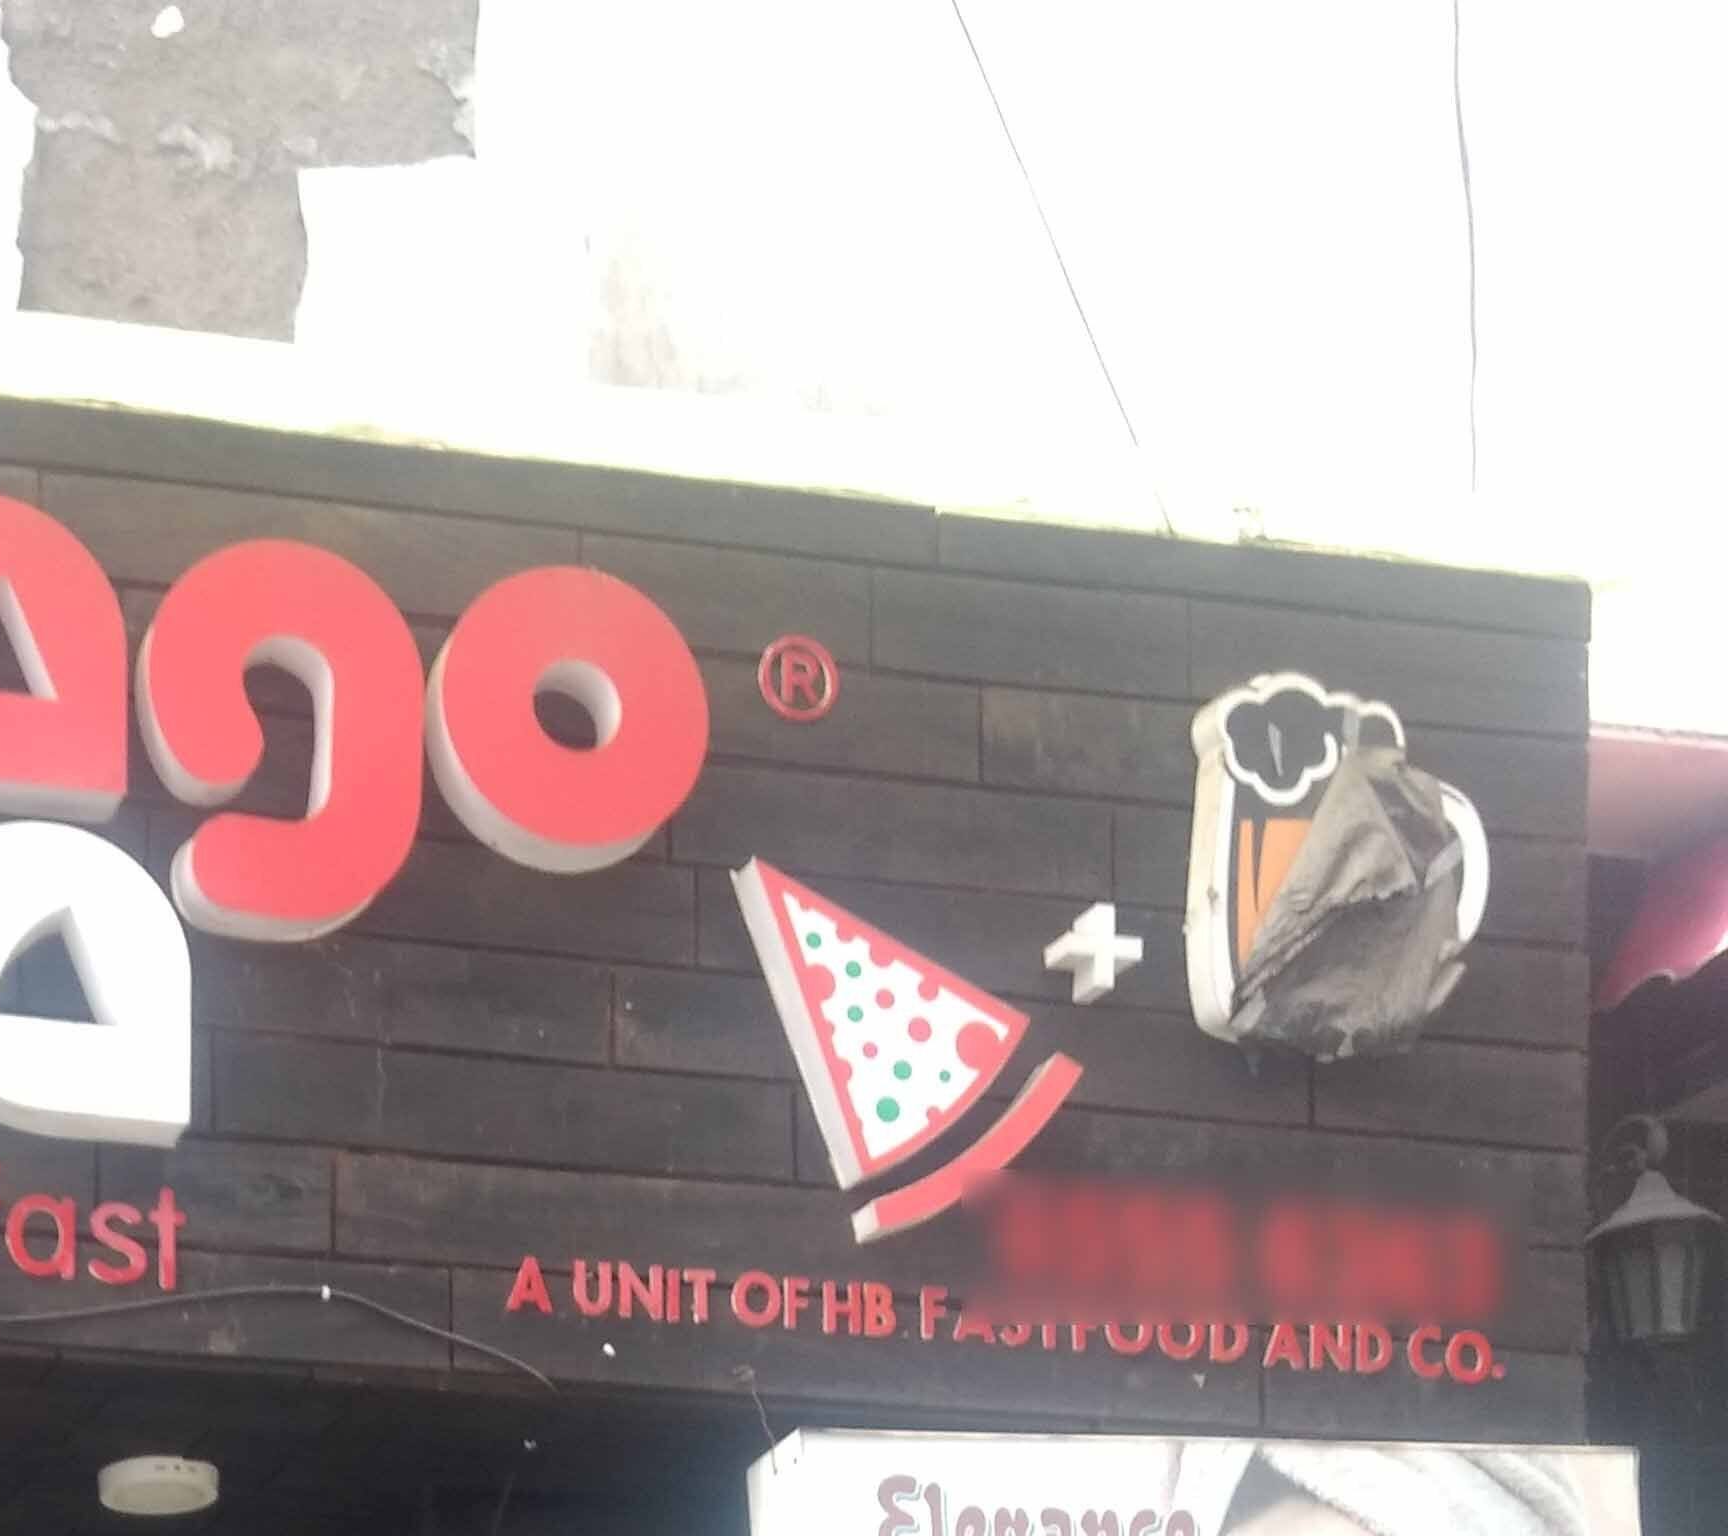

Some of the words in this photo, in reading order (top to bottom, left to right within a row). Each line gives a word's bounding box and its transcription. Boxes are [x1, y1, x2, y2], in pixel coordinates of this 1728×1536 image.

[505, 1255, 553, 1314] A
[573, 1258, 717, 1325] UNIT
[730, 1270, 810, 1330] OF
[1262, 1315, 1393, 1374] AND
[1407, 1325, 1506, 1385] CO.
